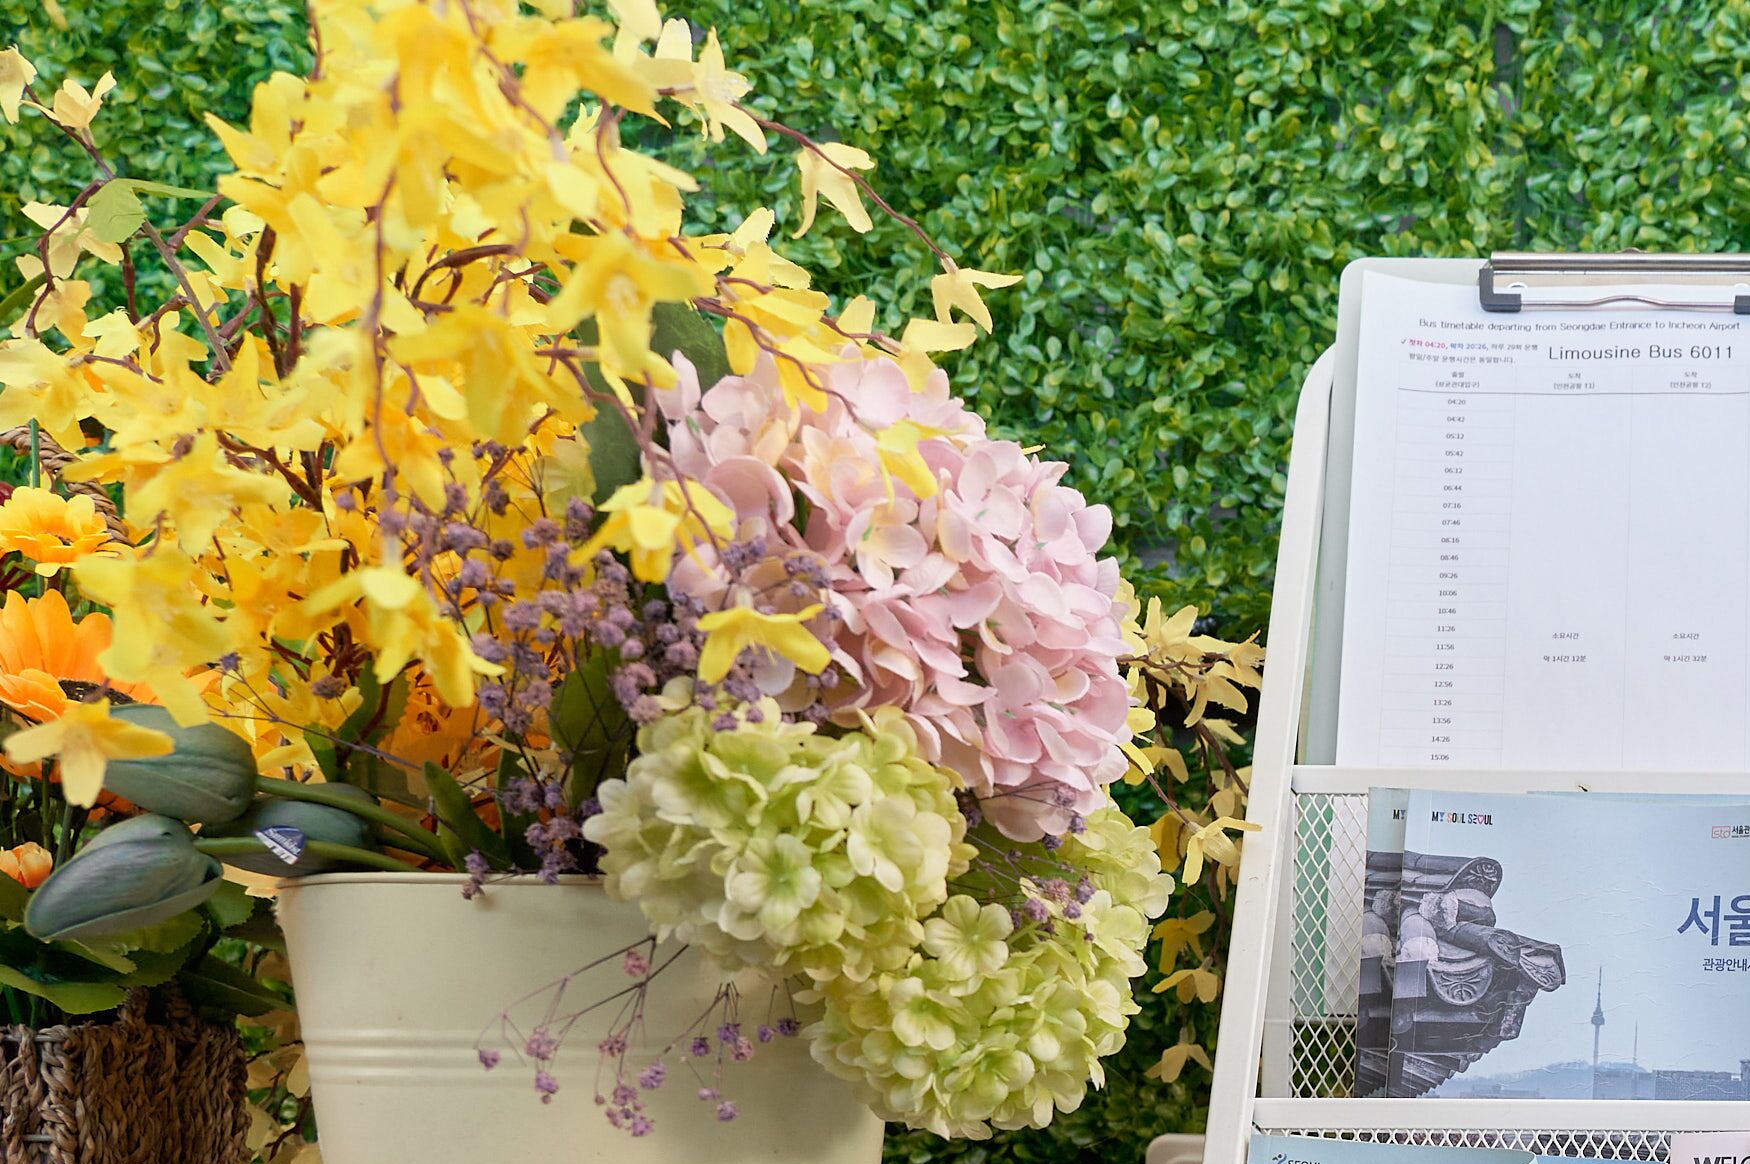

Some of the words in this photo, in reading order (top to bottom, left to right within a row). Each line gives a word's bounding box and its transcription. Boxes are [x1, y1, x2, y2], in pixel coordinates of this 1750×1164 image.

[1419, 318, 1437, 328] Bus
[1441, 320, 1485, 330] timetable
[1488, 321, 1531, 332] departing
[1535, 322, 1557, 331] from
[1560, 322, 1606, 332] Seongdae
[1609, 320, 1651, 330] Entrance
[1655, 321, 1666, 329] to
[1668, 321, 1705, 330] Incheon
[1709, 321, 1740, 331] Airport
[1549, 345, 1641, 360] Limousine
[1649, 344, 1683, 359] Bus
[1690, 345, 1732, 359] 6011
